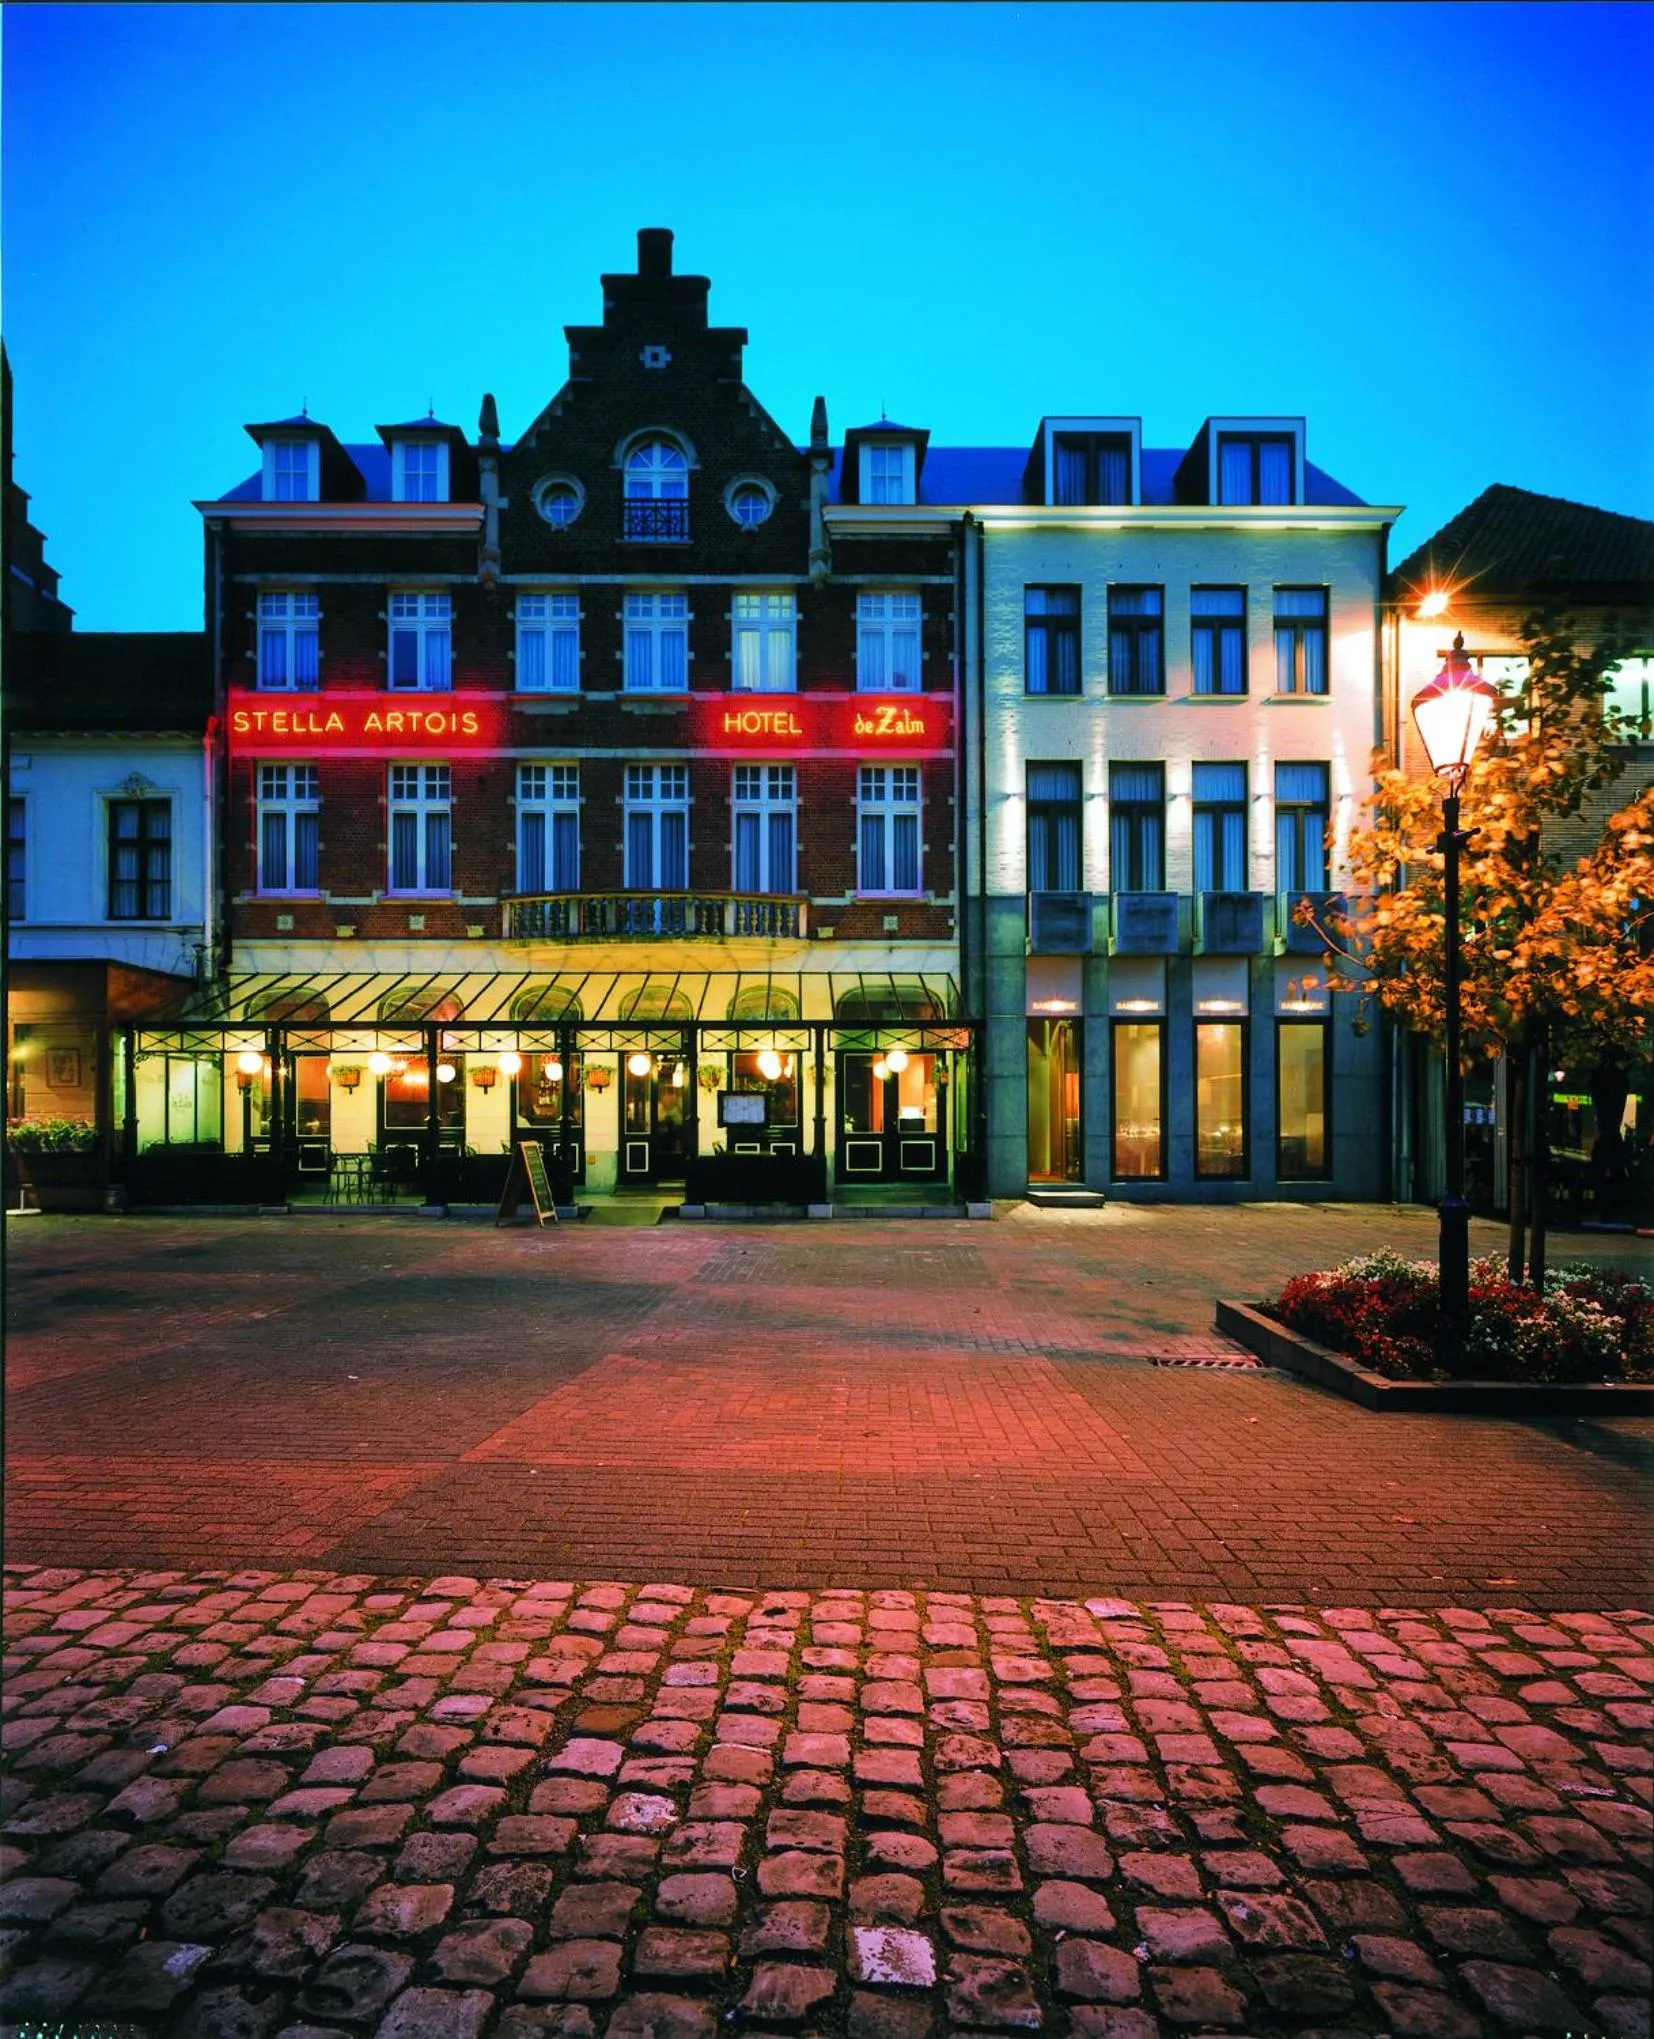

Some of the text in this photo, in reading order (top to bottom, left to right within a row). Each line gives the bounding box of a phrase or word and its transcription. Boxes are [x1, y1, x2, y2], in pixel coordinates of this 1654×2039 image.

[233, 711, 479, 733] STELLA ARTOIS
[724, 711, 803, 734] HOTEL
